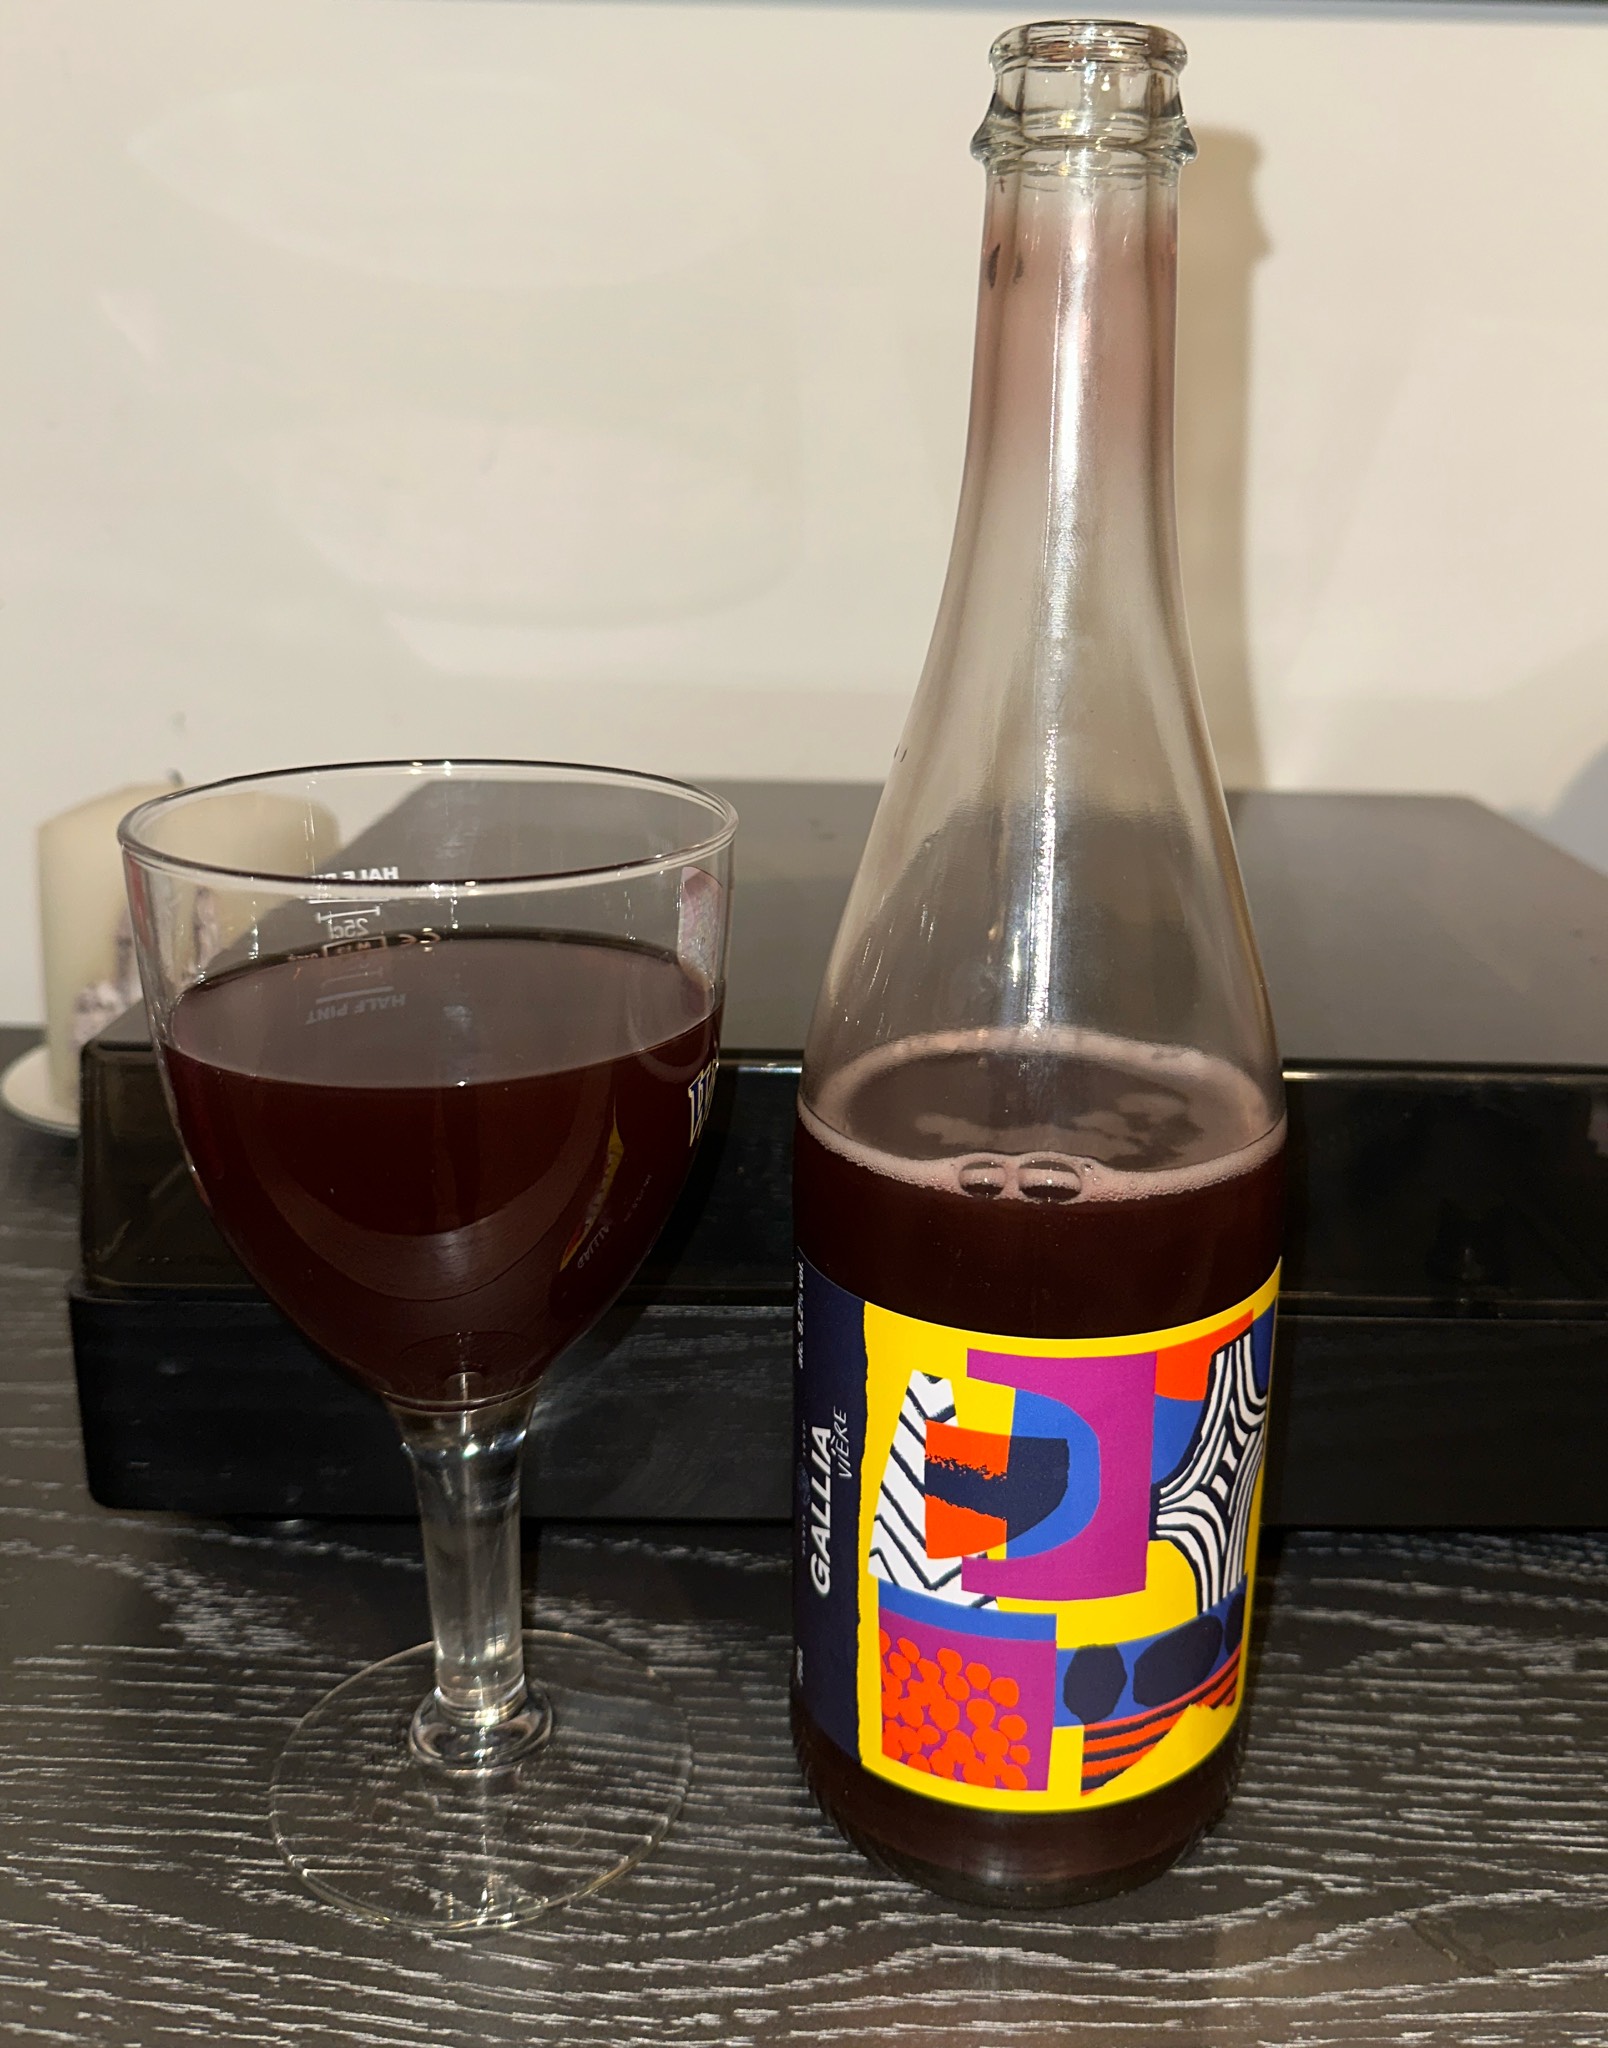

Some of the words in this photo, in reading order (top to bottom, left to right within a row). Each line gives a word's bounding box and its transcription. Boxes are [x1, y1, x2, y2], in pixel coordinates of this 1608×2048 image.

[304, 1003, 348, 1026] PINT
[353, 993, 407, 1015] HALF
[810, 1426, 831, 1597] GALLIA
